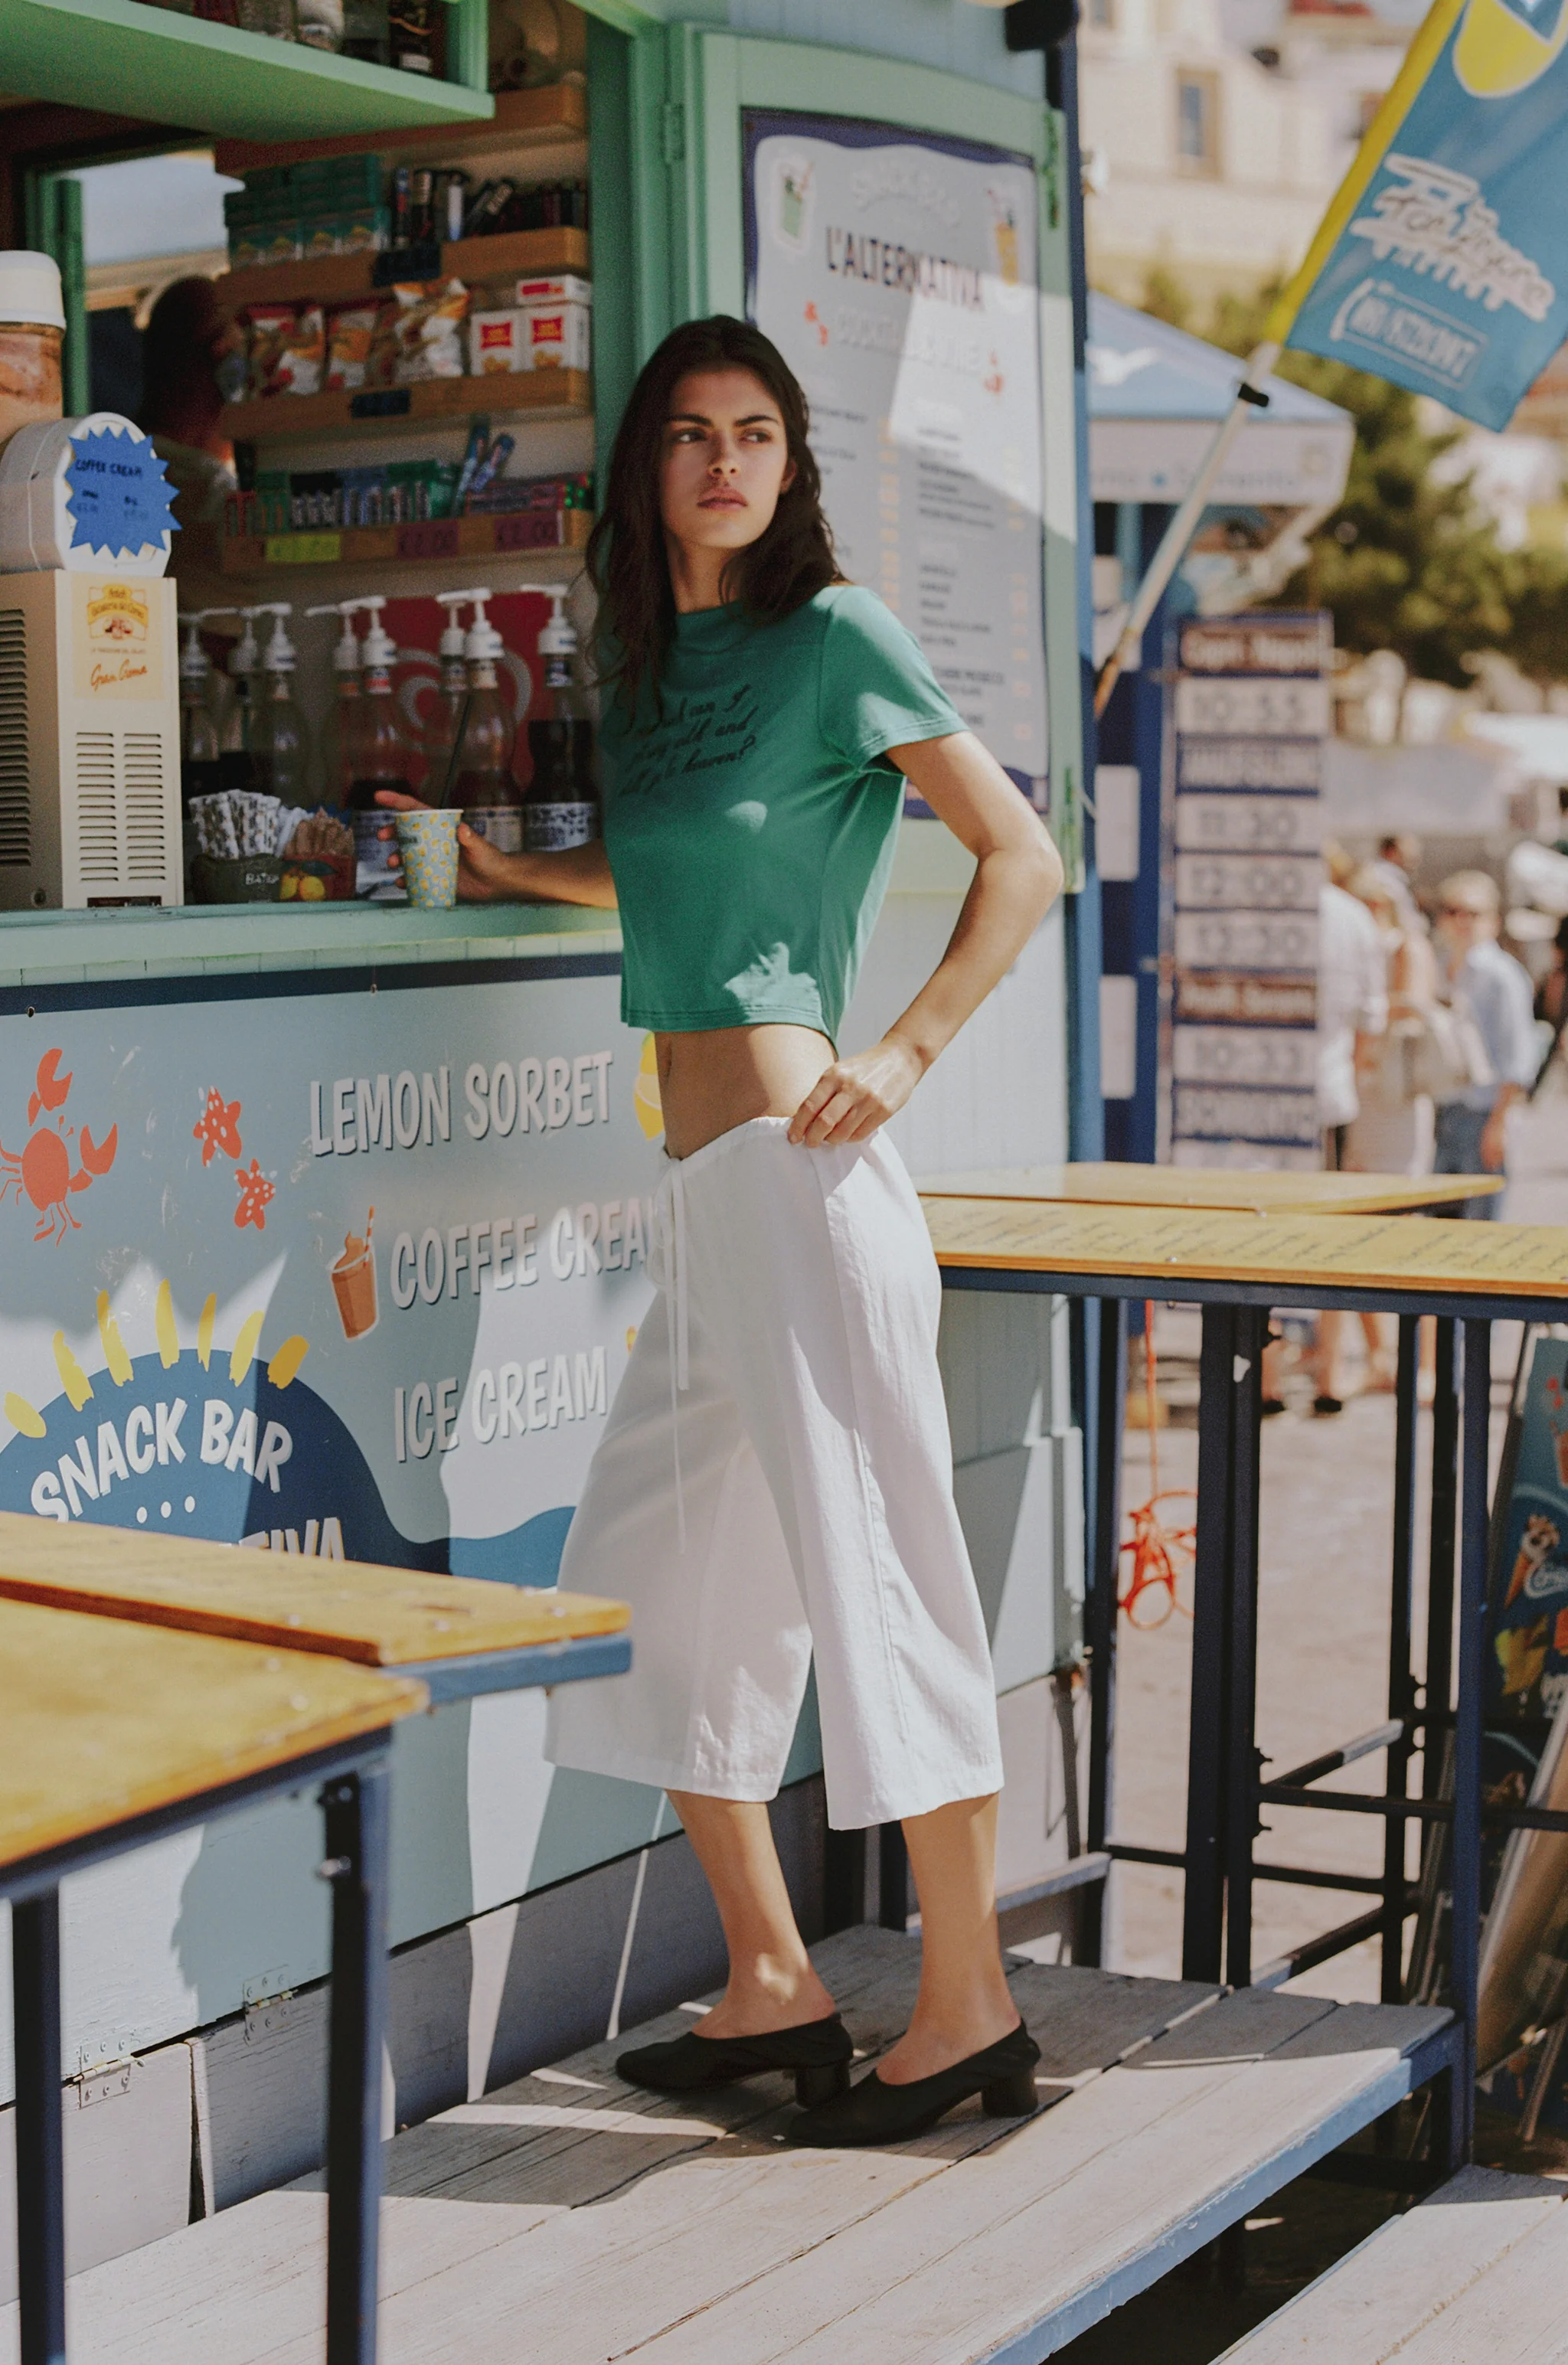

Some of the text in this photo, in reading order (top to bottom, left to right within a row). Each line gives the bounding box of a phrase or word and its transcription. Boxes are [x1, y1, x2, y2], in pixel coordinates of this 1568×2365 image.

[826, 227, 986, 311] L'ALTERNATIVA
[311, 1050, 613, 1158] LEMON SORBET
[389, 1197, 653, 1310] COFFEE CREA
[394, 1345, 609, 1463] ICE CREAM
[30, 1397, 293, 1525] SNACK BAR
